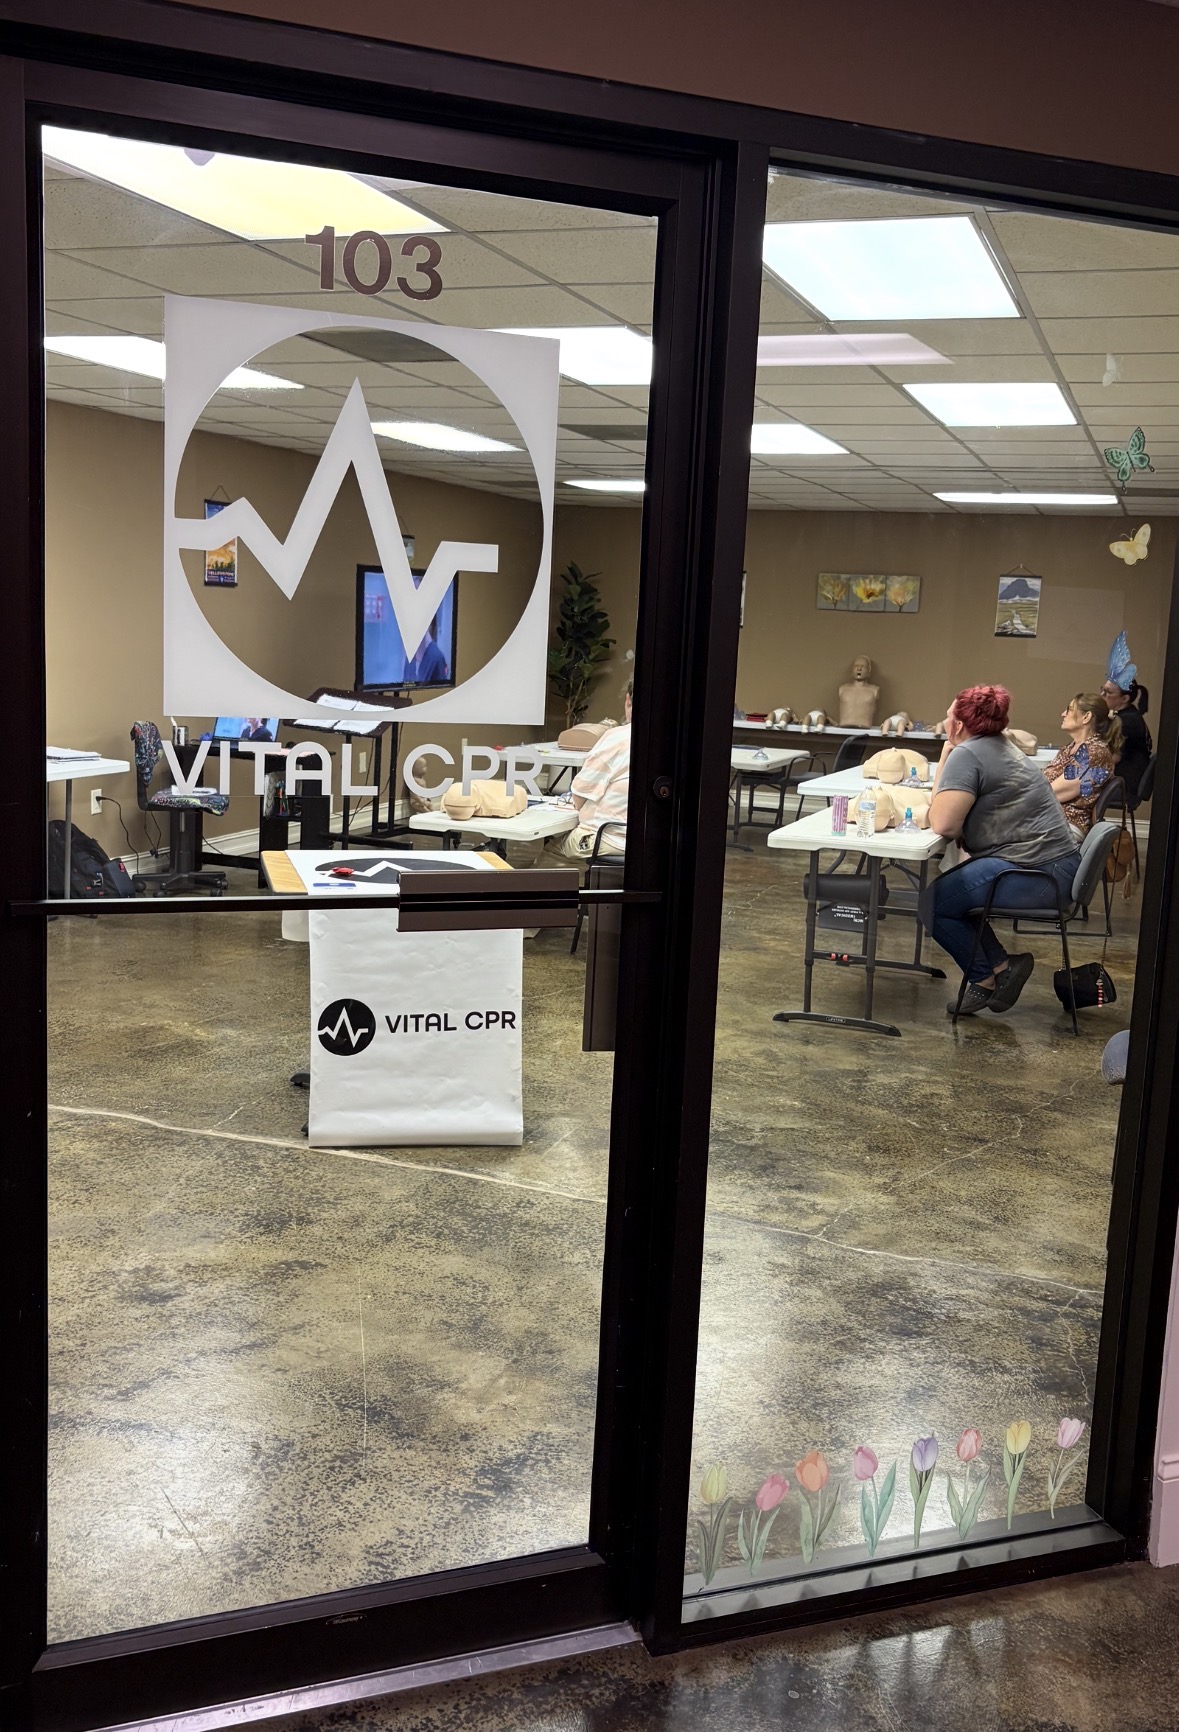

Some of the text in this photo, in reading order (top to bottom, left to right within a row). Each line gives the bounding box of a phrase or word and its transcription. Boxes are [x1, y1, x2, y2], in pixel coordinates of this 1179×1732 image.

[305, 225, 443, 301] 103
[161, 740, 544, 798] VITAL CPR
[384, 1010, 516, 1034] VITAL CPR
